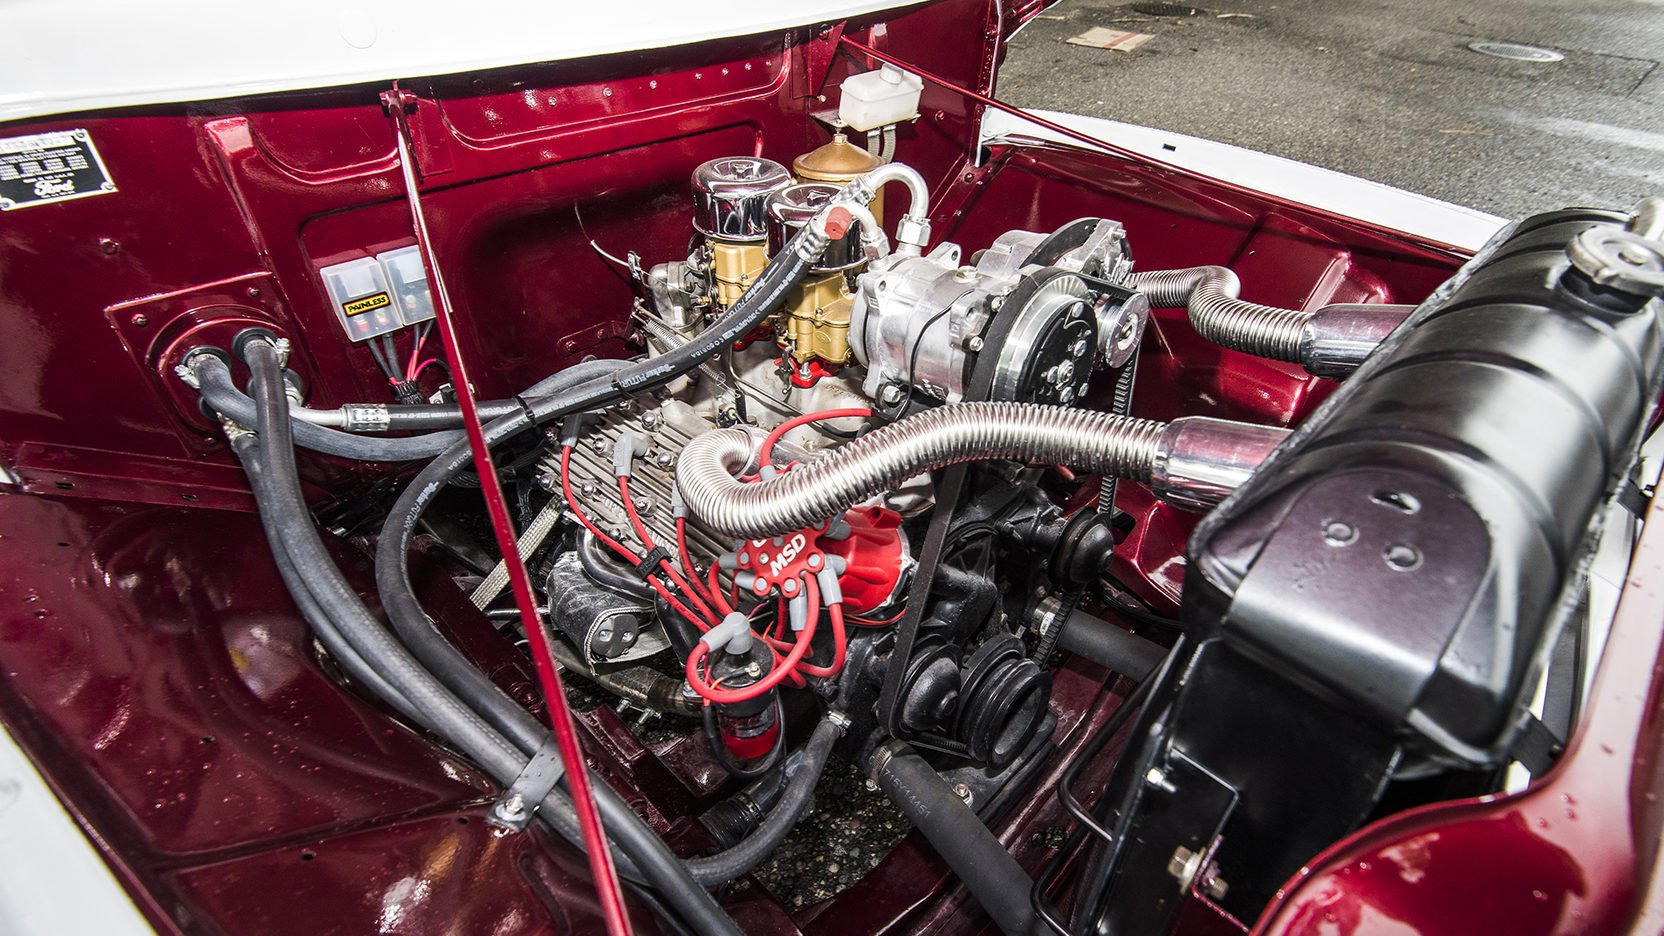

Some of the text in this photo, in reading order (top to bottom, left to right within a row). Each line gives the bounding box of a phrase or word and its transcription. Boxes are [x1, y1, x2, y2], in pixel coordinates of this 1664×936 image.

[34, 180, 75, 196] Ford
[347, 297, 386, 312] PAINLESS
[619, 364, 672, 388] Parker FUTUR
[417, 482, 435, 505] Parker
[770, 534, 806, 577] MSD
